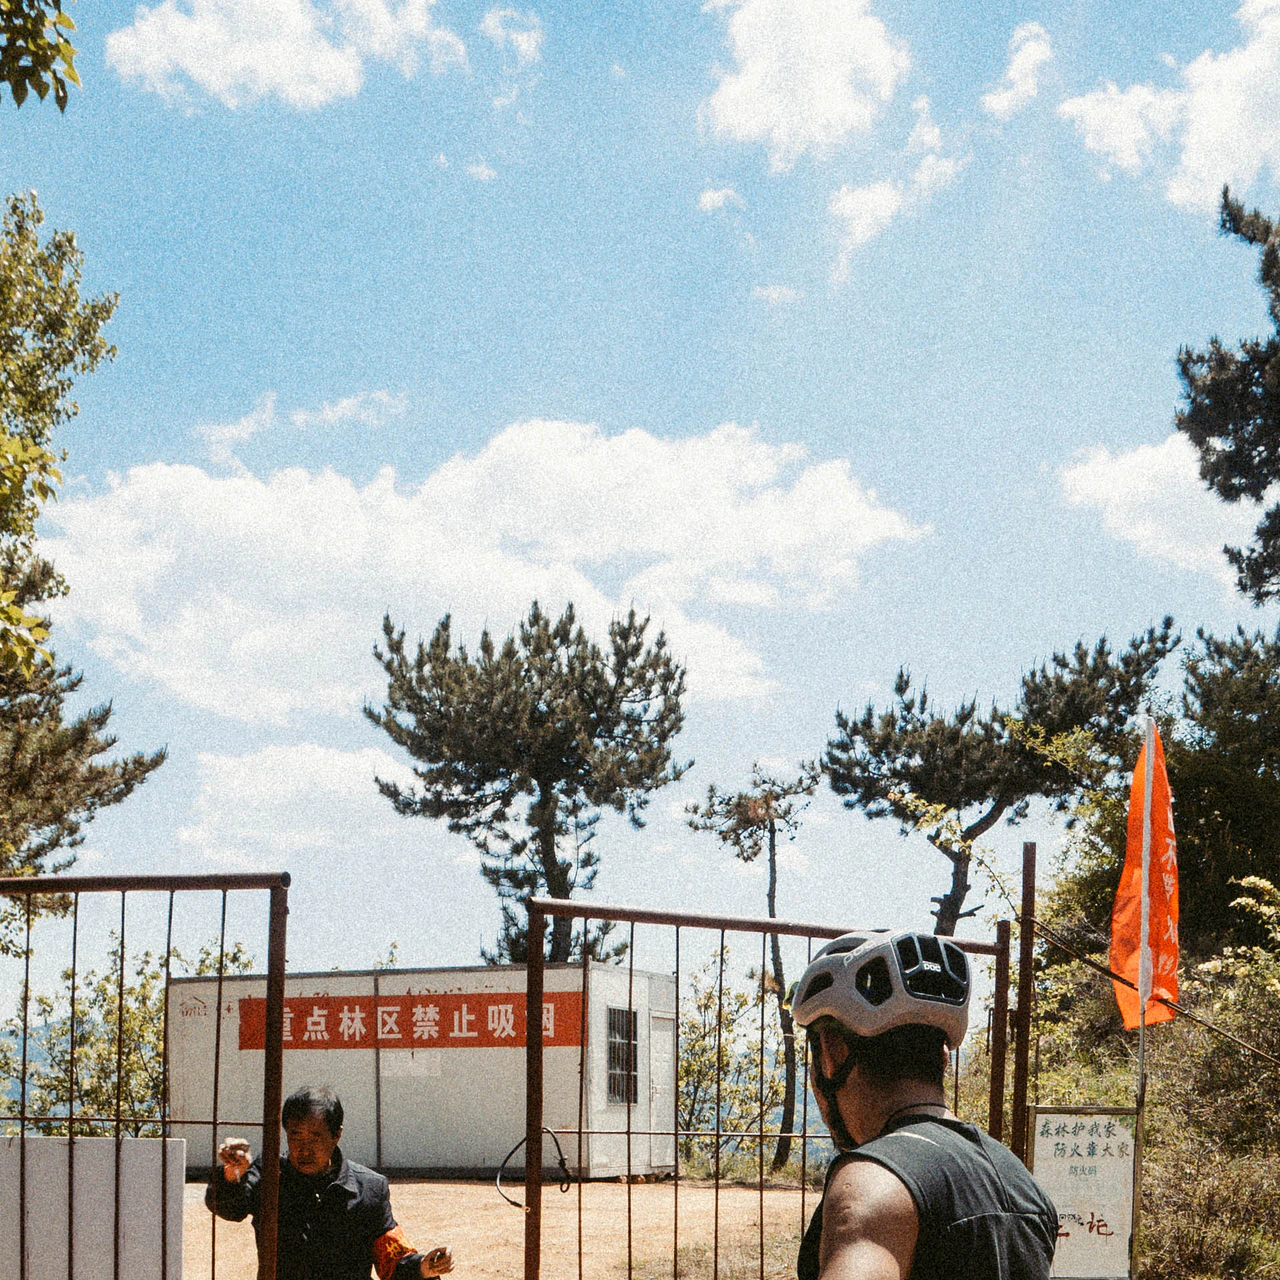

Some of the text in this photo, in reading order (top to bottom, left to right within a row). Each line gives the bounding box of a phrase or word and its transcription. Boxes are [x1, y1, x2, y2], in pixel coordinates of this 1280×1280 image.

[1040, 1119, 1116, 1137] 森林护我家
[1054, 1142, 1129, 1157] 防火靠大家
